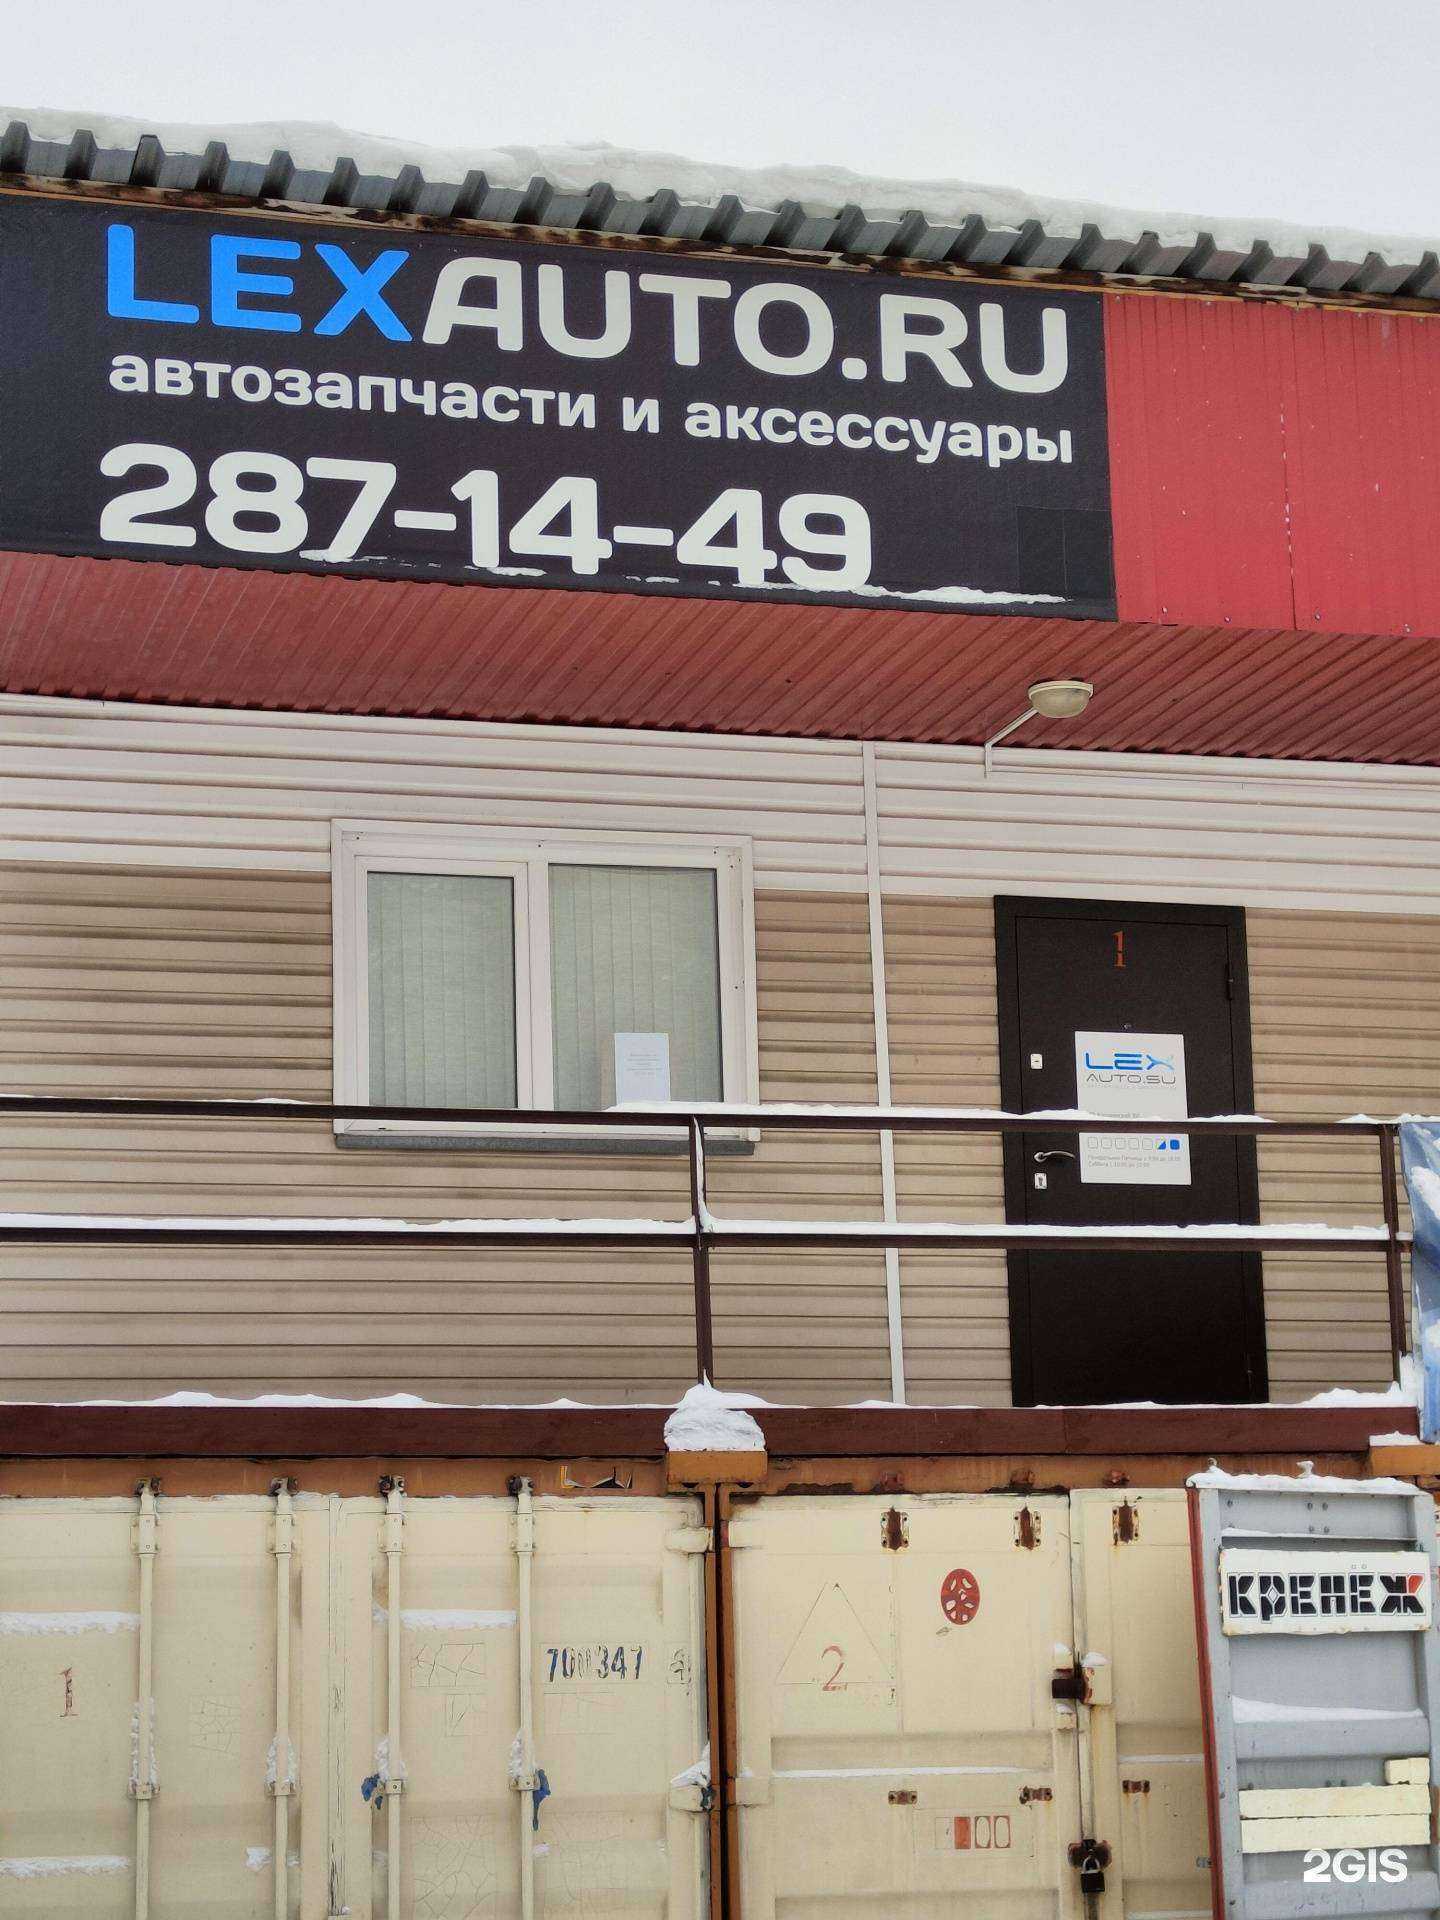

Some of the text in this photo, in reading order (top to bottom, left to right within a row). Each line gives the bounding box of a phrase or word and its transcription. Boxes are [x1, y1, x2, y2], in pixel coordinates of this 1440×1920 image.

[107, 224, 1069, 394] LEXAUTO.RU
[109, 354, 1073, 468] автозапчасти и аксессуары
[99, 442, 872, 590] 287-14-49
